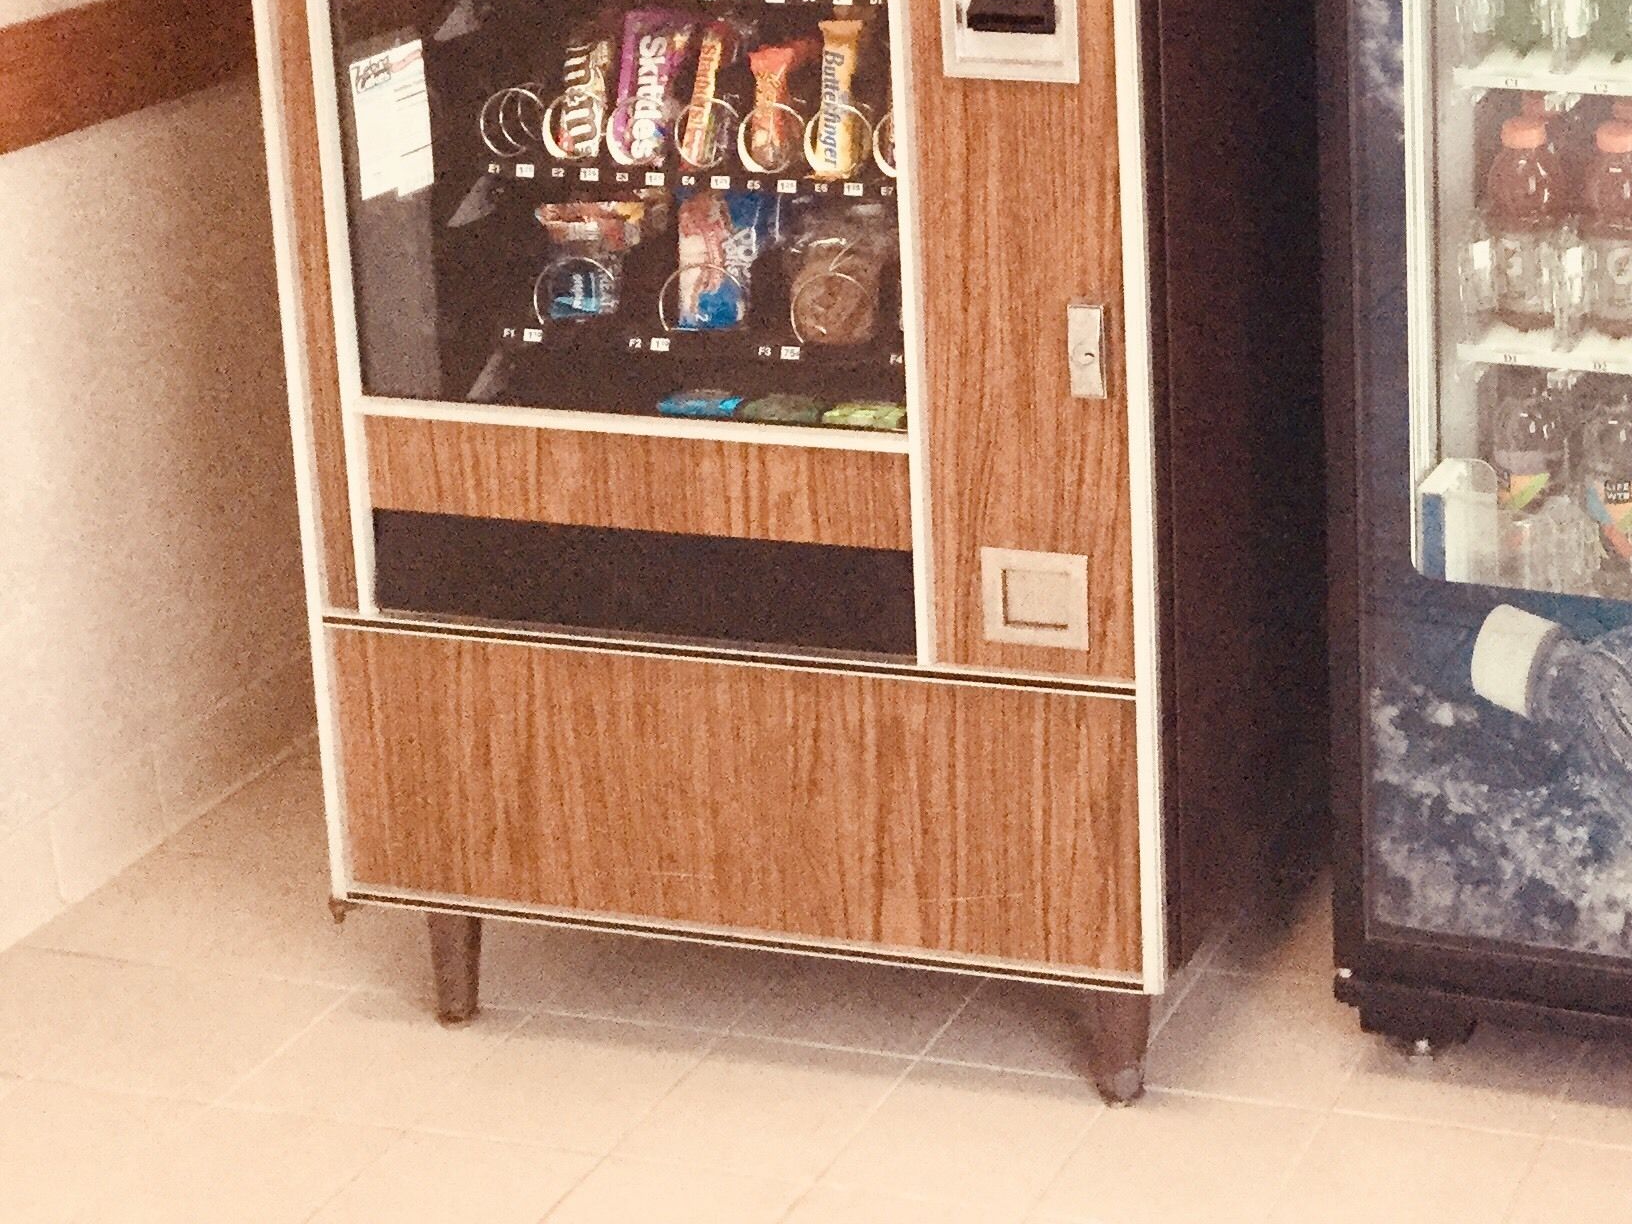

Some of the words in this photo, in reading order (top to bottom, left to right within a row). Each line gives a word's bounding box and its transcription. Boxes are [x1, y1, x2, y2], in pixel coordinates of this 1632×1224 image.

[630, 35, 668, 160] Skittles
[822, 50, 845, 167] Butterfinger
[503, 328, 515, 338] F1
[629, 338, 642, 349] F2
[758, 346, 772, 356] F3
[1606, 481, 1630, 492] LIFE
[1606, 491, 1631, 501] WTR
